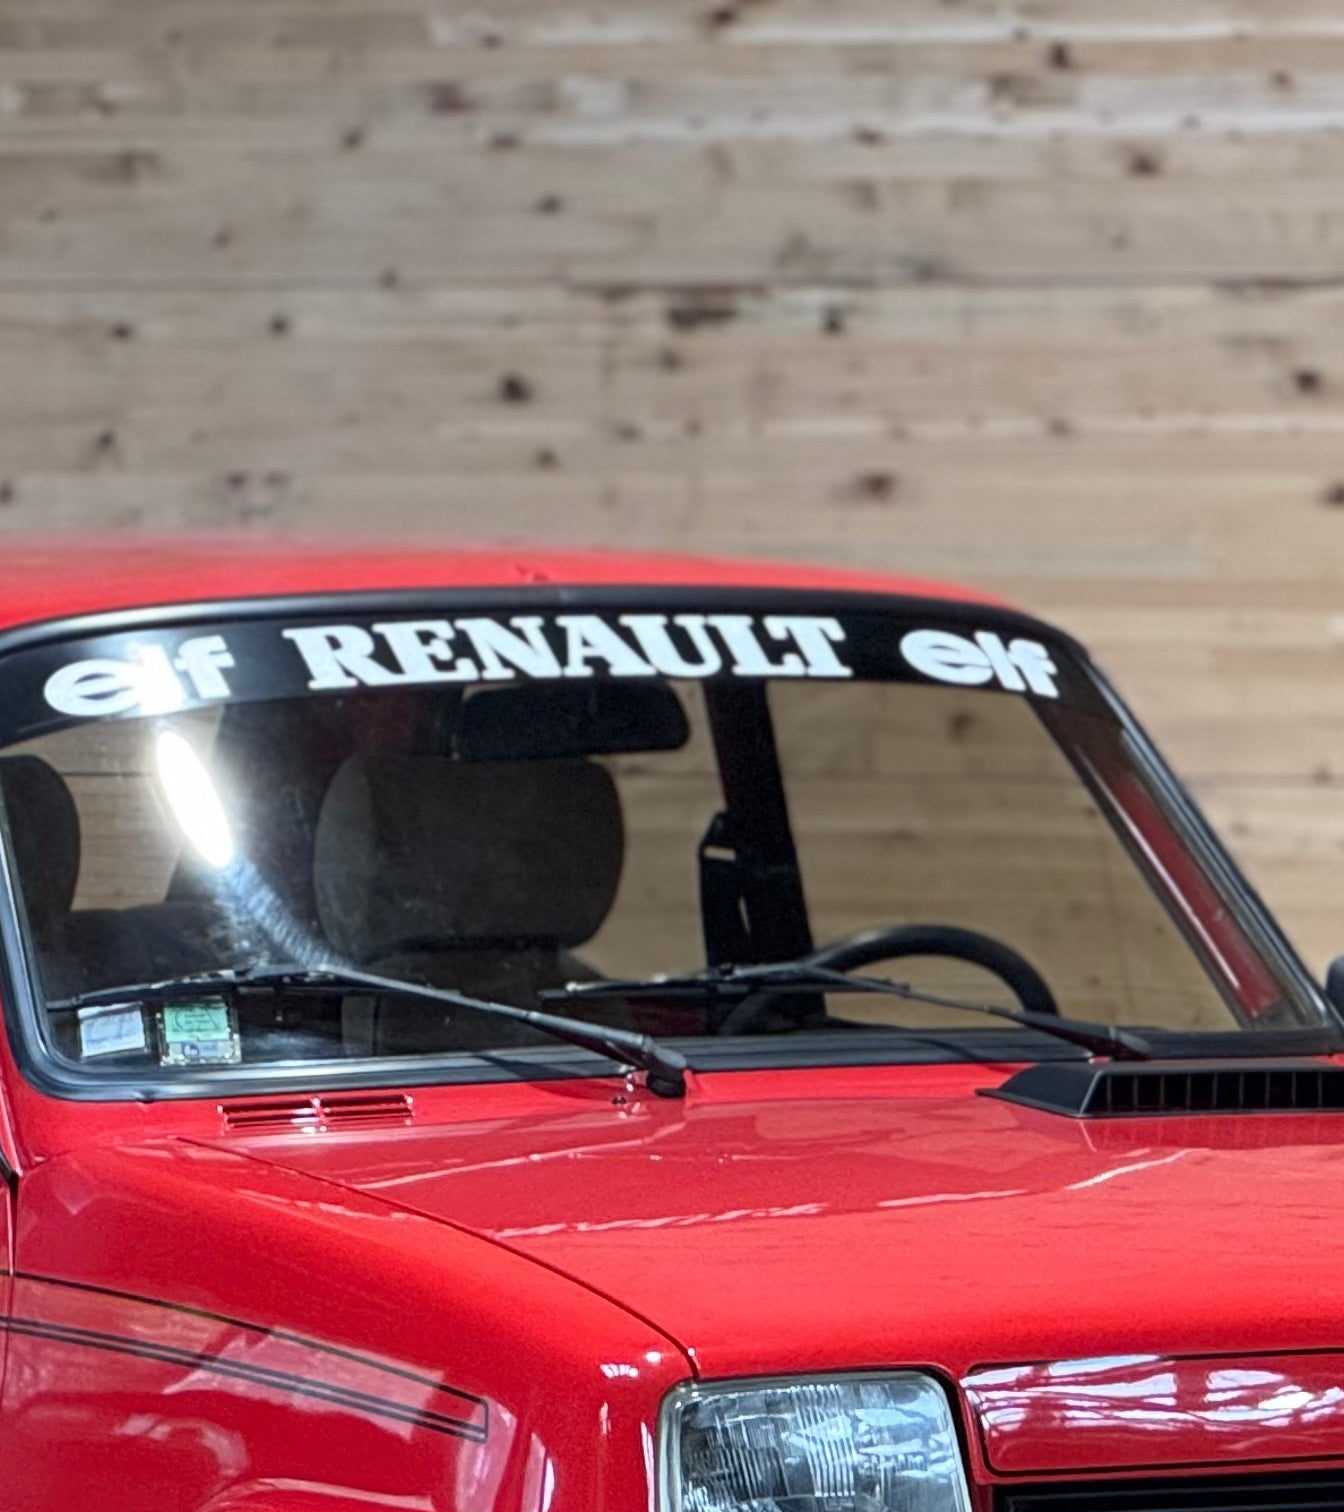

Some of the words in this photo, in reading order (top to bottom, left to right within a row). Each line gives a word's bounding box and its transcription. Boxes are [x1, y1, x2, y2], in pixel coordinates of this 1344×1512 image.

[44, 633, 237, 718] elf
[280, 613, 856, 692] RENAULT
[898, 627, 1060, 699] elf
